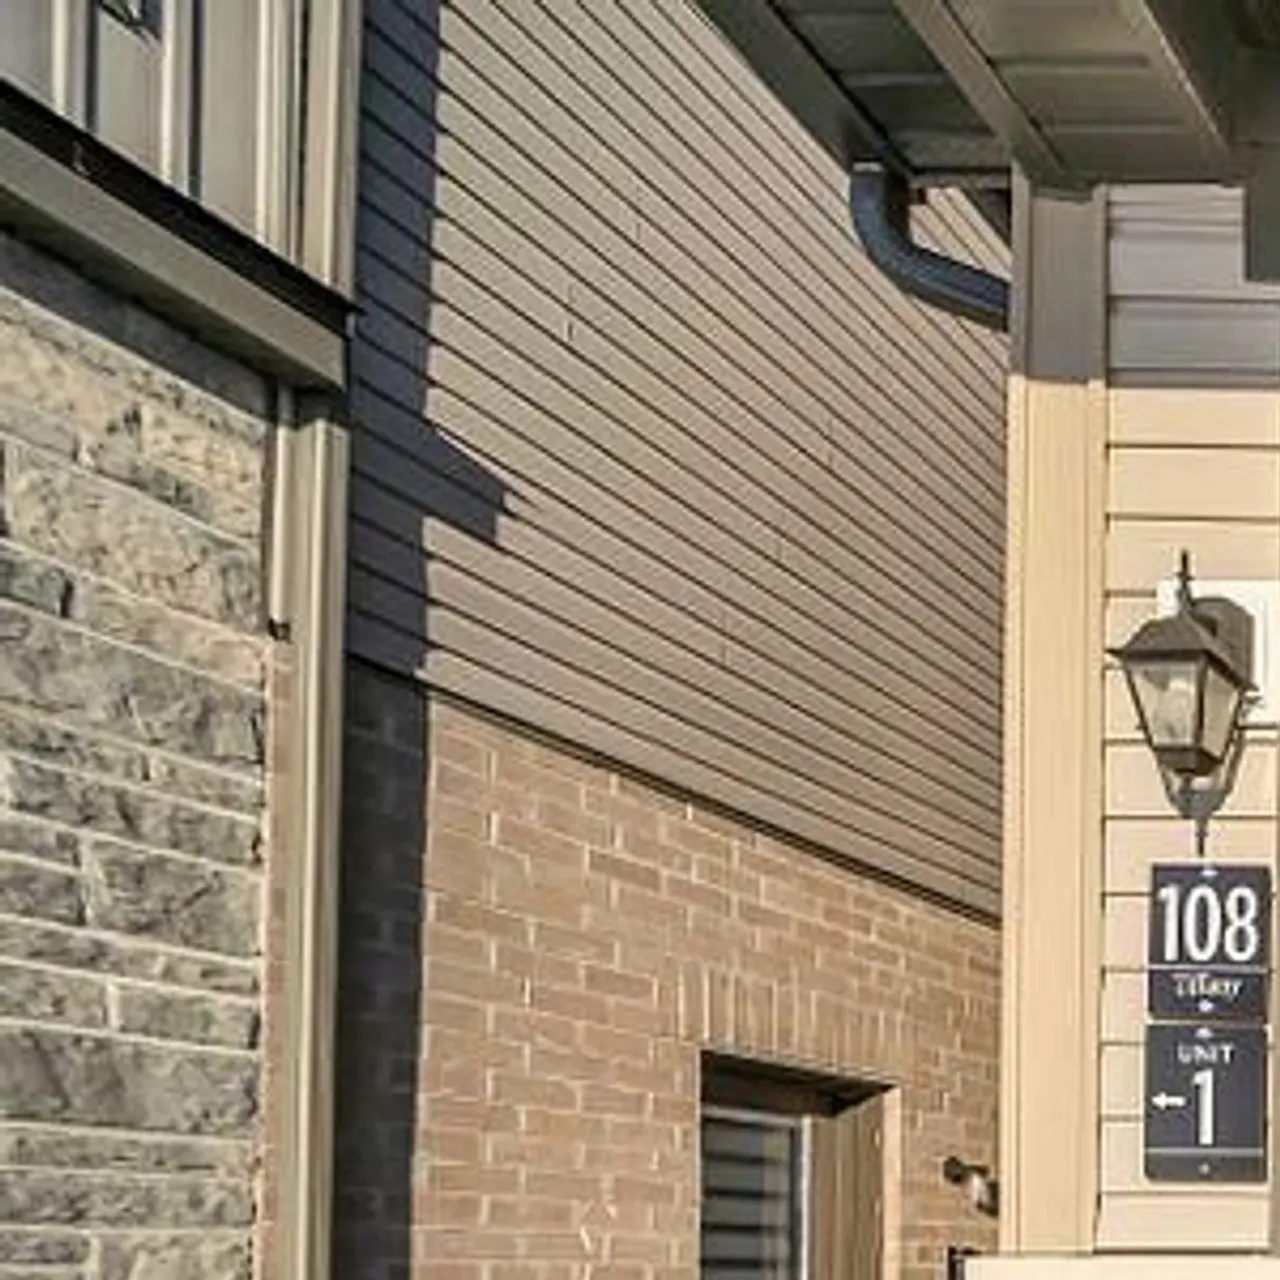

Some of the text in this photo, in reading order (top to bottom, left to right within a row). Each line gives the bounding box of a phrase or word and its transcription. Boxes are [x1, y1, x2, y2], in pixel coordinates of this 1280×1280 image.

[1157, 884, 1259, 962] 108
[1176, 1042, 1235, 1064] UNIT
[1193, 1068, 1214, 1146] 1
